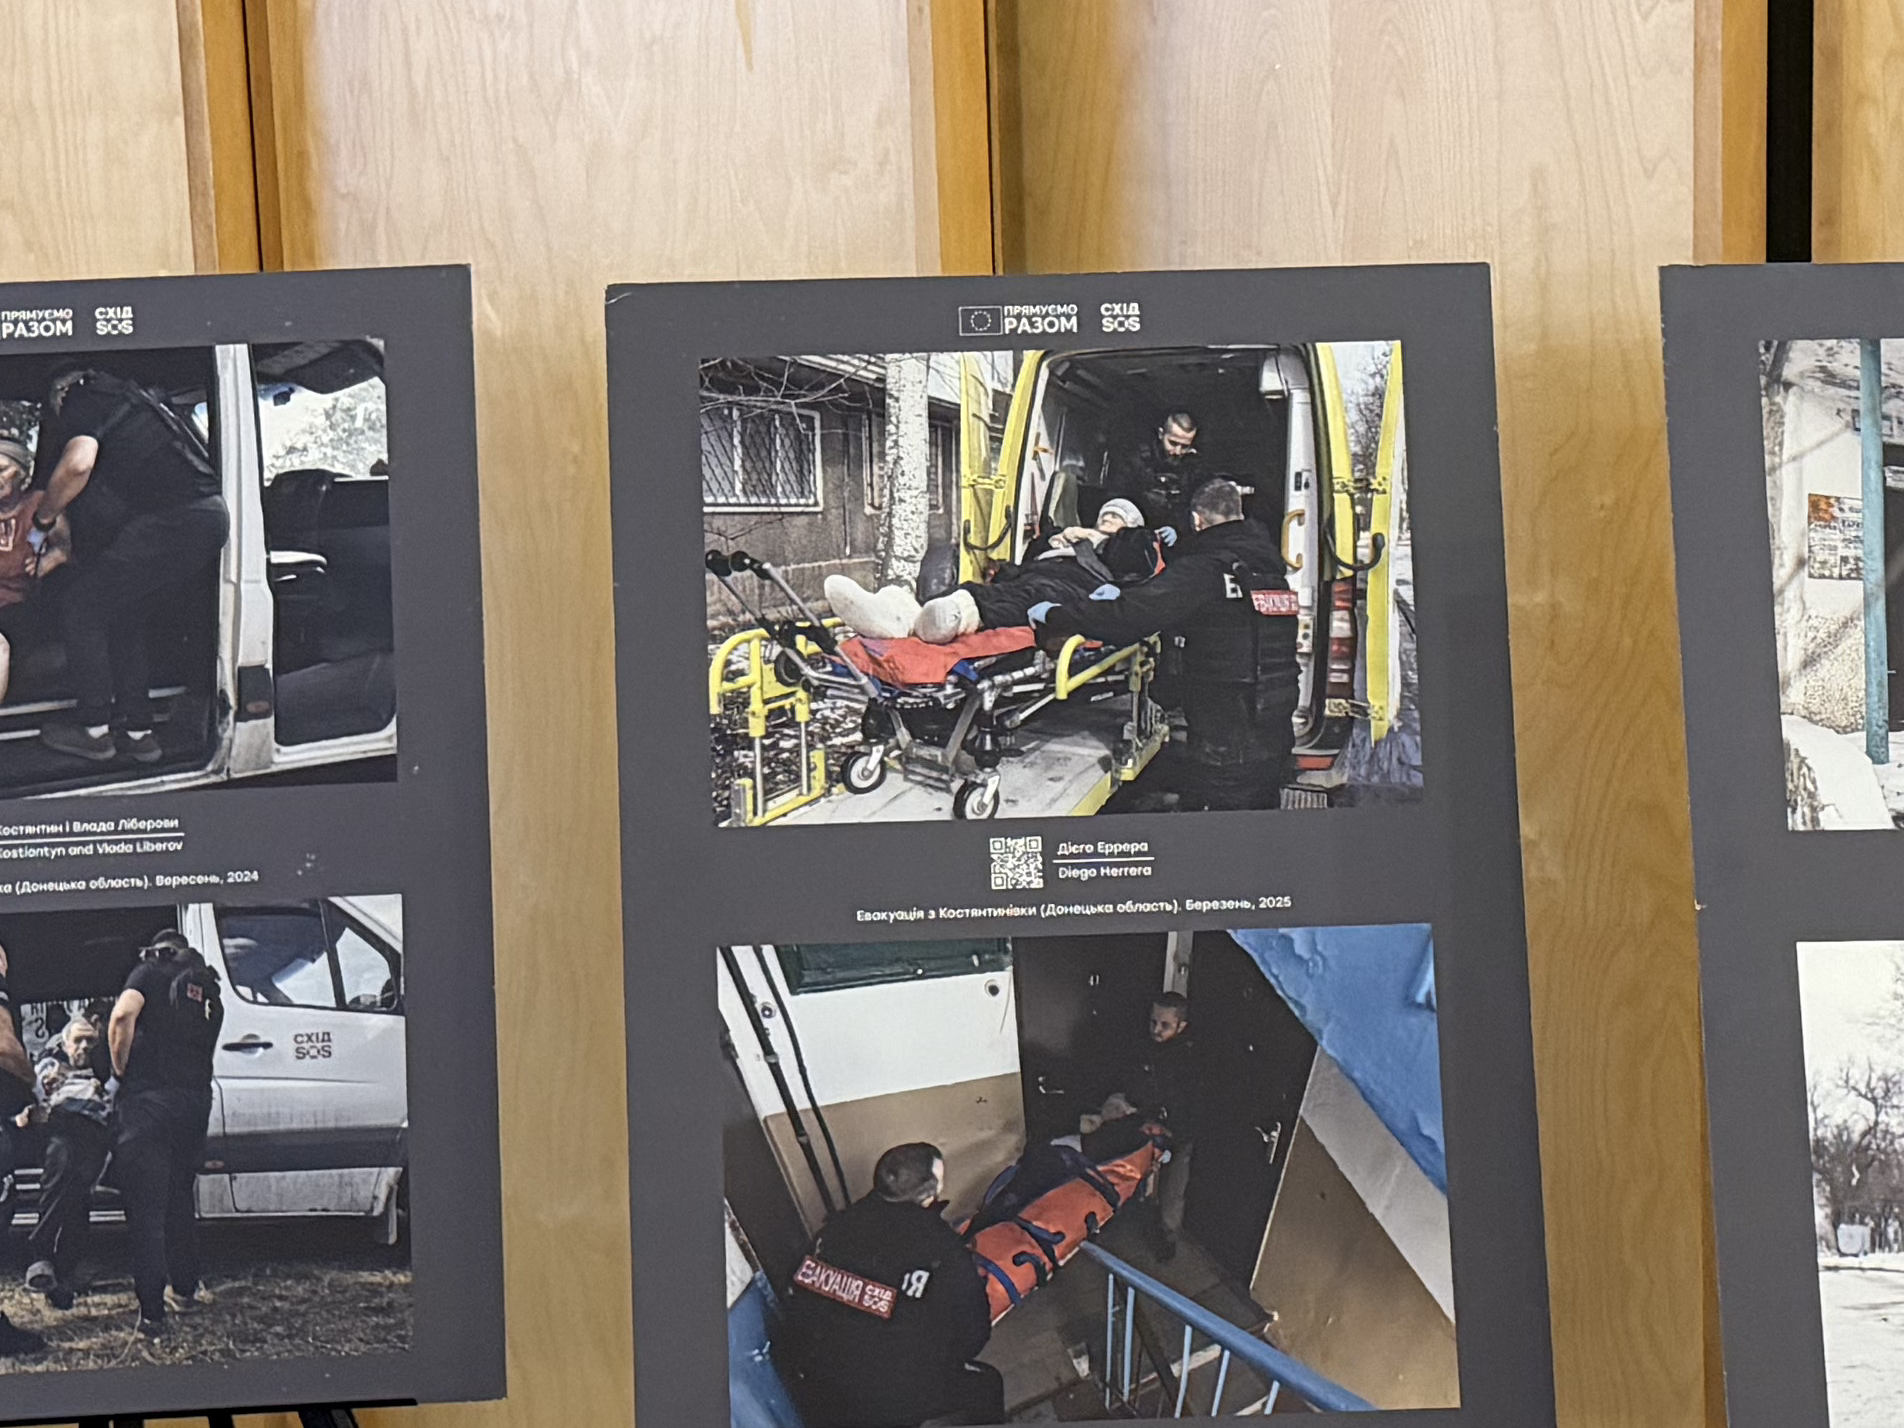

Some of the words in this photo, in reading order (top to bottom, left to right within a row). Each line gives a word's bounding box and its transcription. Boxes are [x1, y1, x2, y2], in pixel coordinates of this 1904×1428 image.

[1, 308, 73, 320] ПРЯМУЄМО
[95, 306, 133, 319] СХІД
[1004, 304, 1077, 316] ПРЯМУЄМО
[1100, 302, 1140, 316] СХІД
[2, 320, 73, 339] РАЗОМ
[96, 319, 133, 335] SOS
[1005, 316, 1078, 333] РАЗОМ
[1102, 316, 1140, 332] SOS
[72, 821, 114, 832] Влада
[117, 817, 178, 831] Ліберови
[67, 843, 93, 855] and
[96, 841, 133, 854] Vlada
[135, 840, 183, 852] Liberov
[1056, 841, 1094, 855] Дієго
[1097, 841, 1148, 855] Еррера
[1058, 865, 1097, 881] Diego
[1100, 866, 1151, 876] Herrera
[15, 880, 86, 895] (Донецька
[88, 875, 152, 889] область).
[155, 874, 223, 888] Вересень,
[226, 870, 258, 882] 2024
[856, 906, 924, 923] Евакуація
[938, 903, 1036, 918] Костянтинівки
[1040, 903, 1113, 918] (Донецька
[1116, 899, 1181, 914] область).
[1185, 899, 1255, 912] Березень,
[1258, 895, 1291, 908] 2025
[293, 1031, 332, 1044] СХІД
[295, 1044, 332, 1060] SOS
